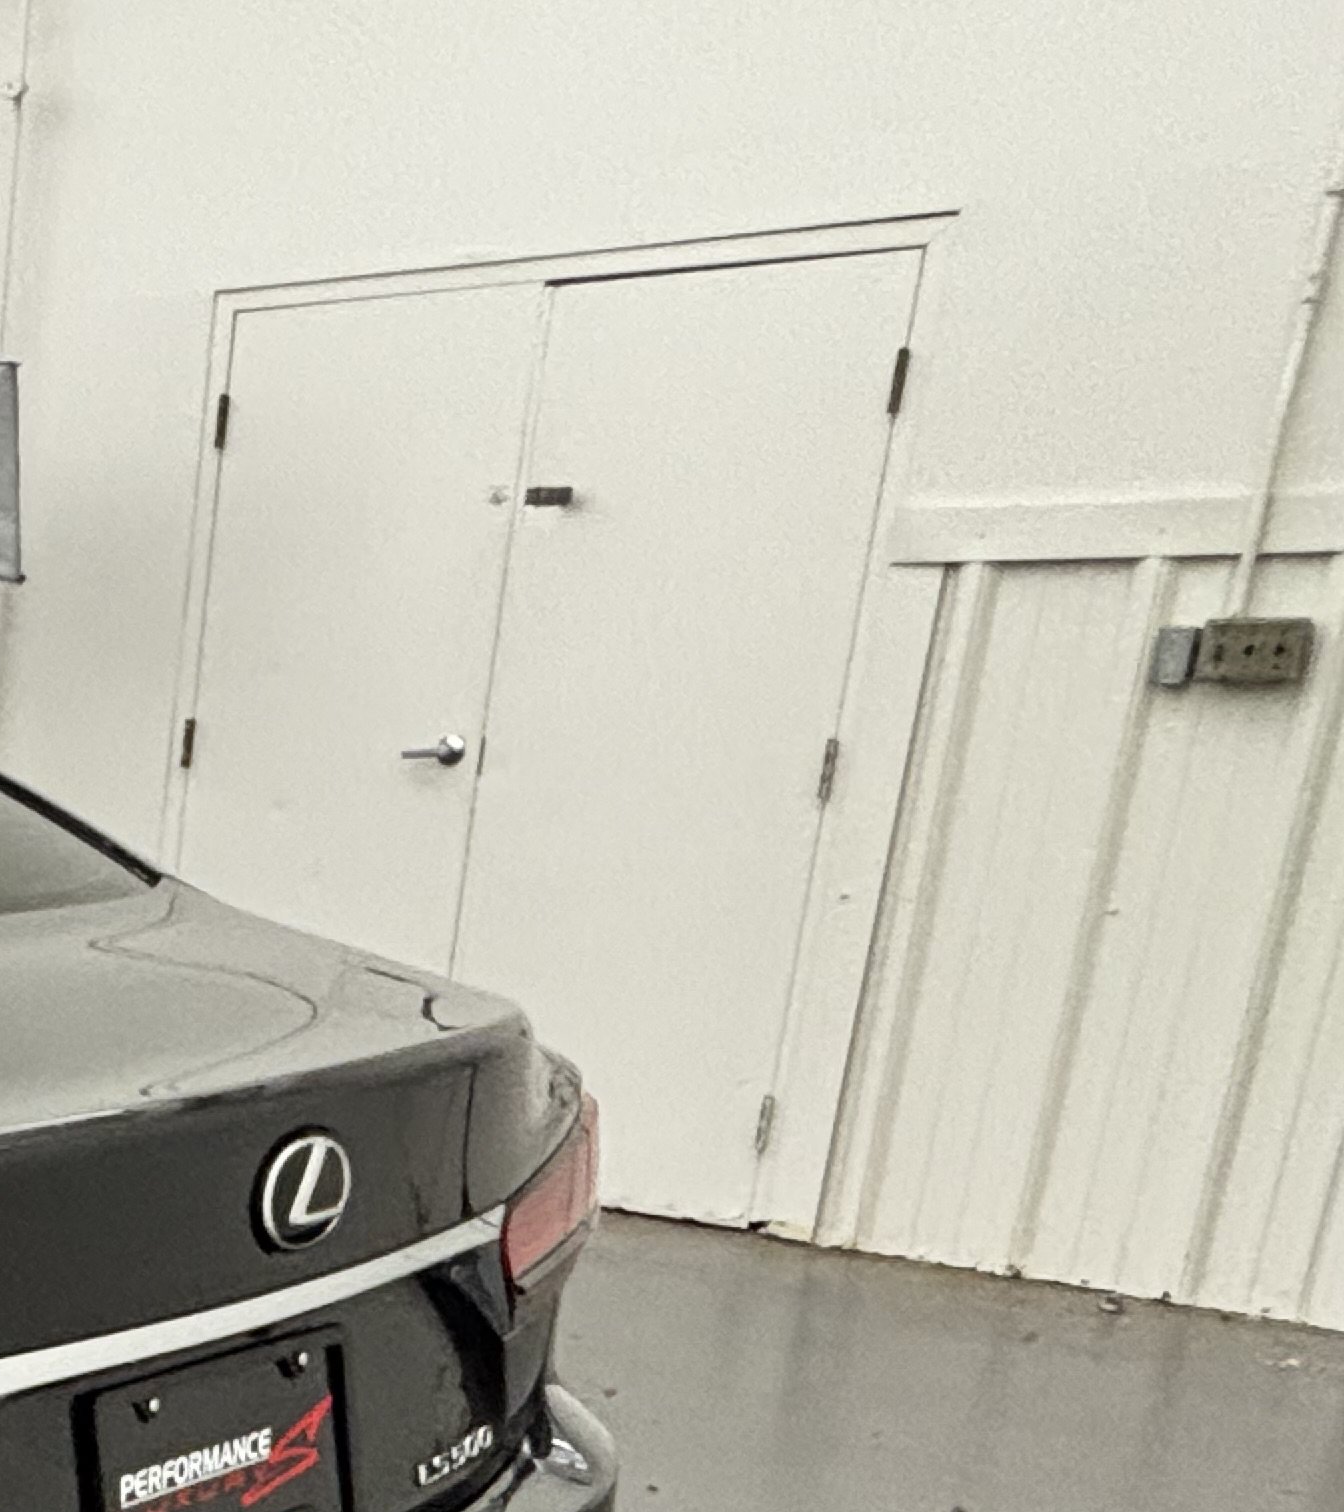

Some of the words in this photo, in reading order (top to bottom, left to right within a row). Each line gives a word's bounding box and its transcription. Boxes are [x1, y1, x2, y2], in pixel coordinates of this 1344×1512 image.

[120, 1427, 272, 1504] PERFORMANCE
[418, 1453, 450, 1486] LS
[450, 1425, 493, 1470] 500
